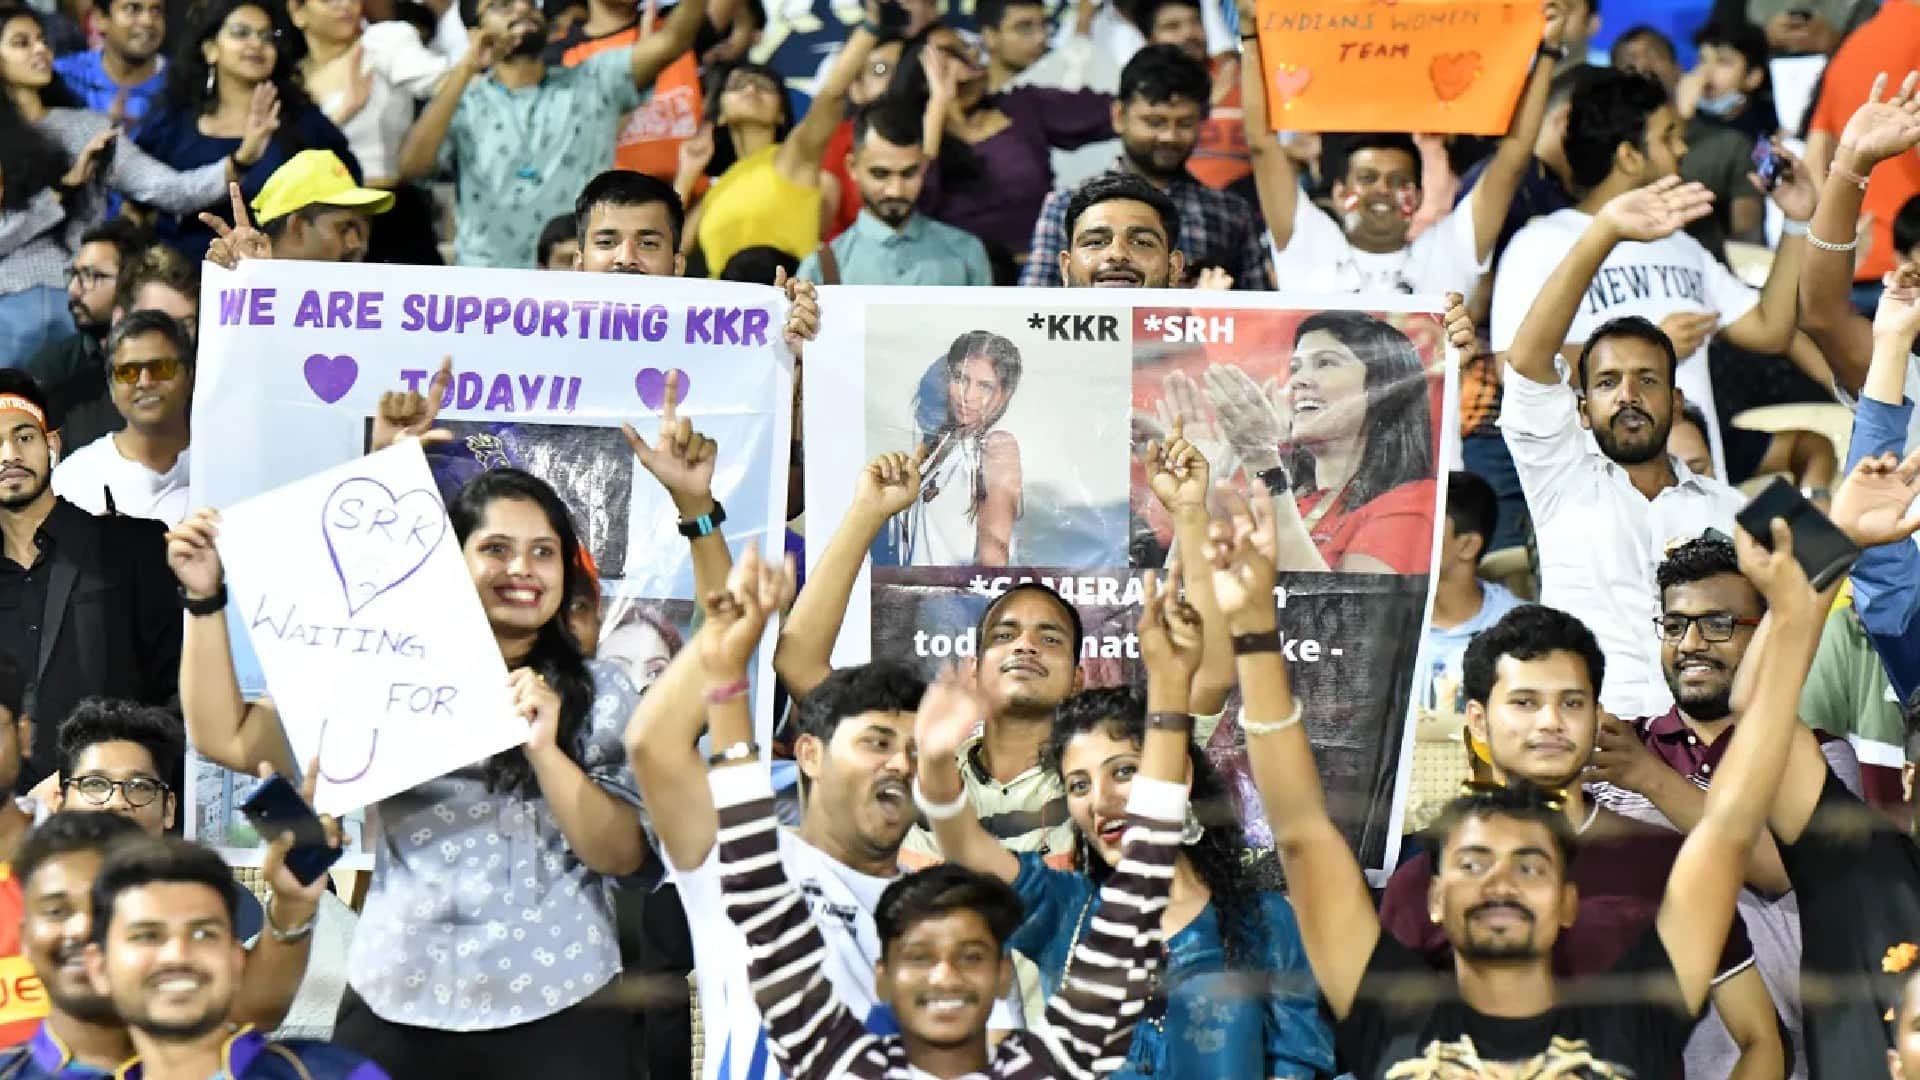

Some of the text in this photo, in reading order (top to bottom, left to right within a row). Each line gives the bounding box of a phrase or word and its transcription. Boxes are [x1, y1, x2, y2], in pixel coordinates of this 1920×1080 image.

[1264, 9, 1481, 32] INDIANS WOMEN
[1339, 43, 1411, 62] TEAM
[1588, 264, 1650, 314] NEW
[219, 287, 771, 347] WE ARE SUPPORTING KKR
[333, 498, 435, 549] SRK
[252, 593, 425, 658] WAITING
[914, 630, 977, 656] tod
[387, 682, 458, 716] FOR
[318, 717, 379, 785] U
